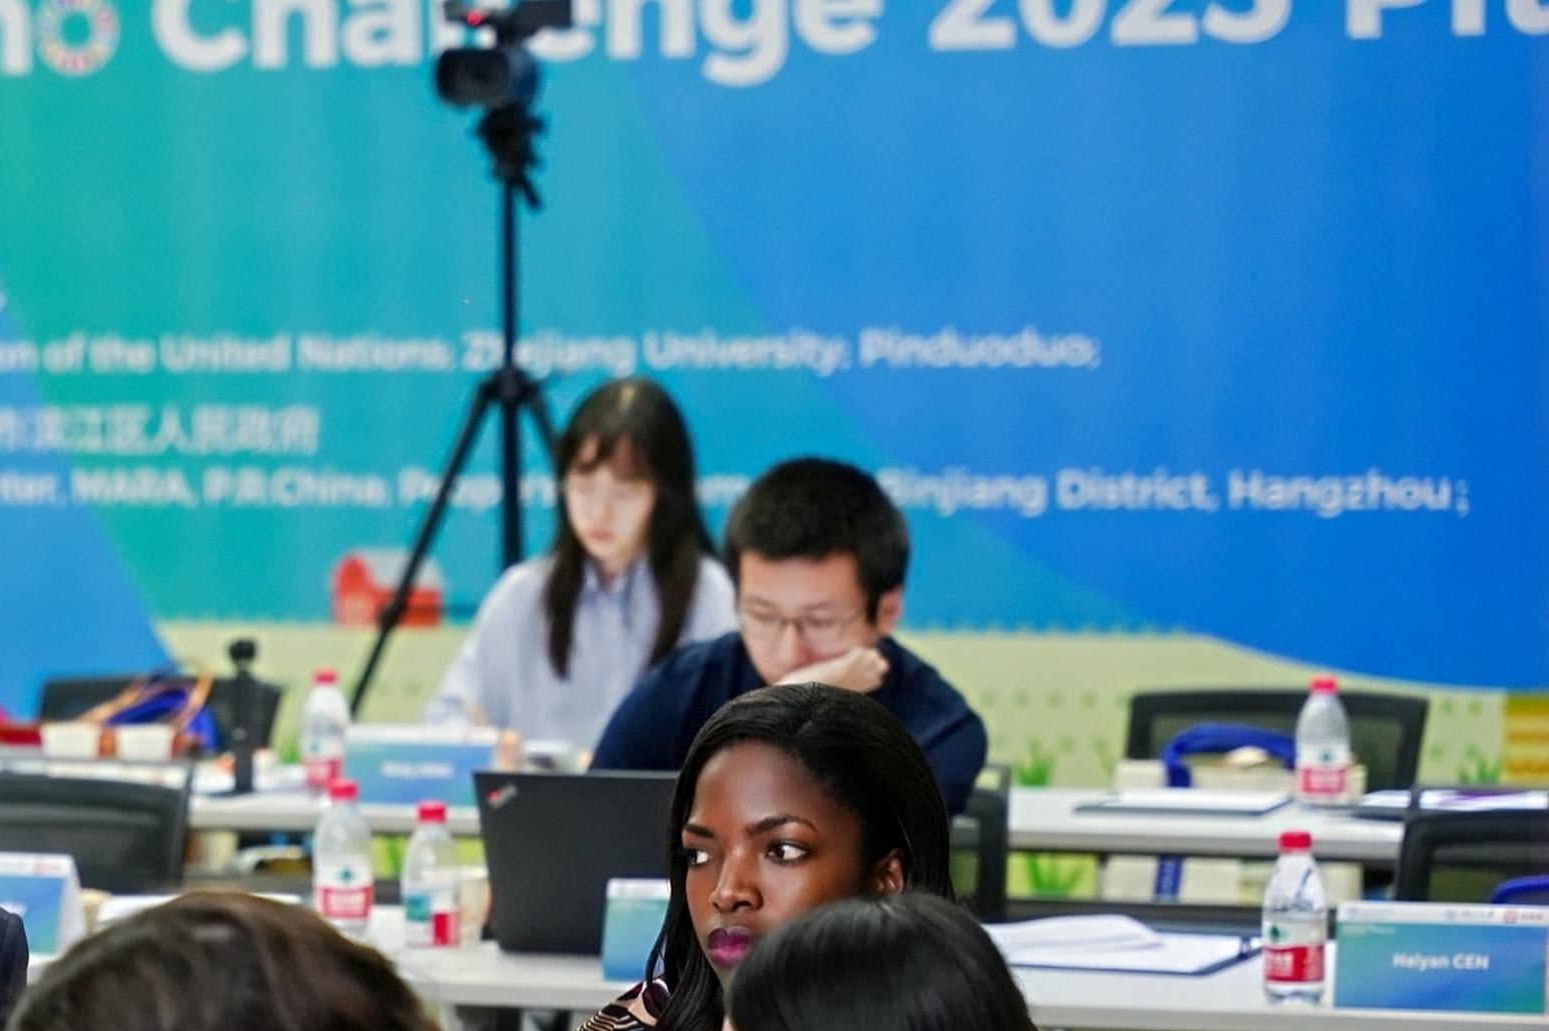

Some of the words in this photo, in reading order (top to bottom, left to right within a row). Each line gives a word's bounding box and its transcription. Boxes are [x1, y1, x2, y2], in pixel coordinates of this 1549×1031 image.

[42, 332, 87, 373] of
[89, 332, 156, 373] the
[159, 332, 291, 373] United
[1393, 952, 1449, 972] Haiyan
[1452, 953, 1489, 970] CEN
